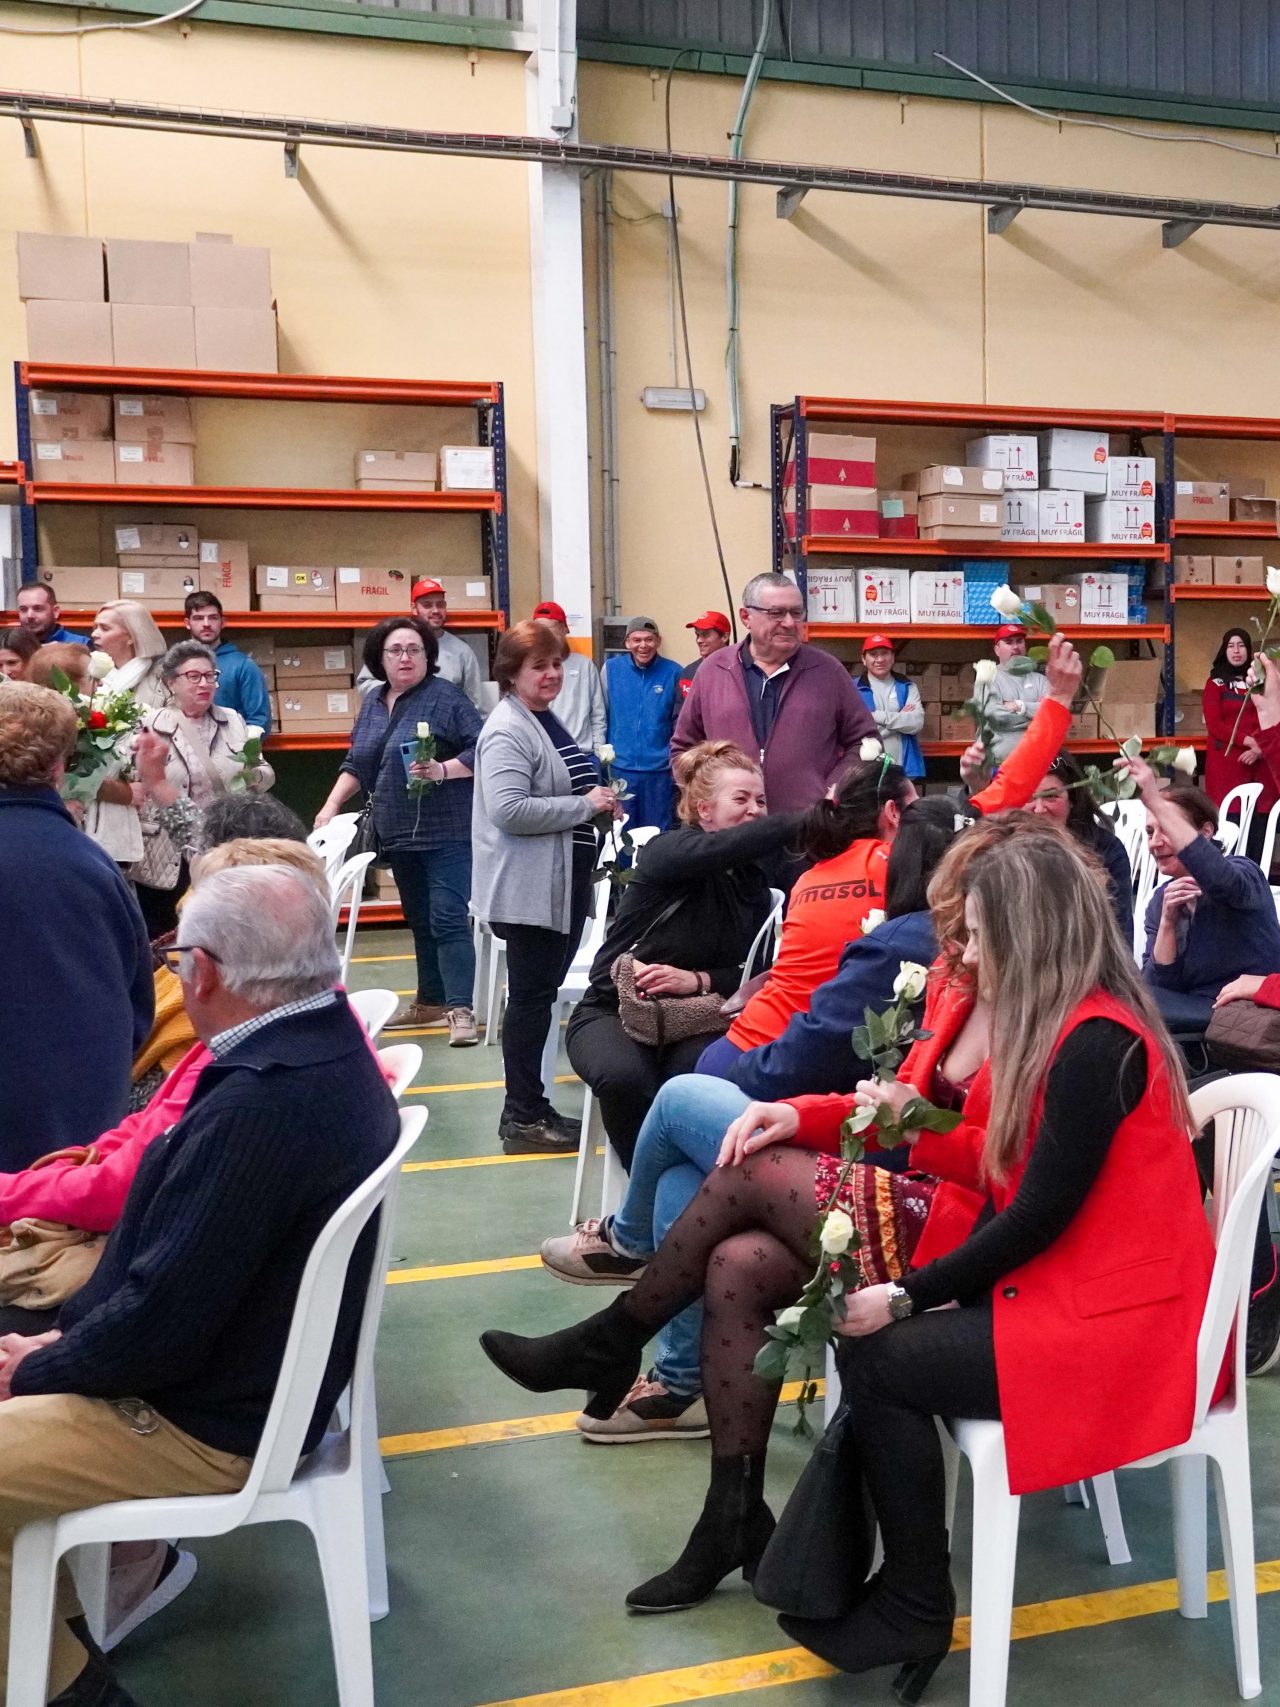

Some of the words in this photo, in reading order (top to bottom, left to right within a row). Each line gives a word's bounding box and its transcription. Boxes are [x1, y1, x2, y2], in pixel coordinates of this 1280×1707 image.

[361, 586, 389, 596] FRAGIL
[884, 607, 908, 616] FRÁGIL
[937, 609, 962, 617] FRÁGIL
[1102, 609, 1125, 619] FRÁGIL
